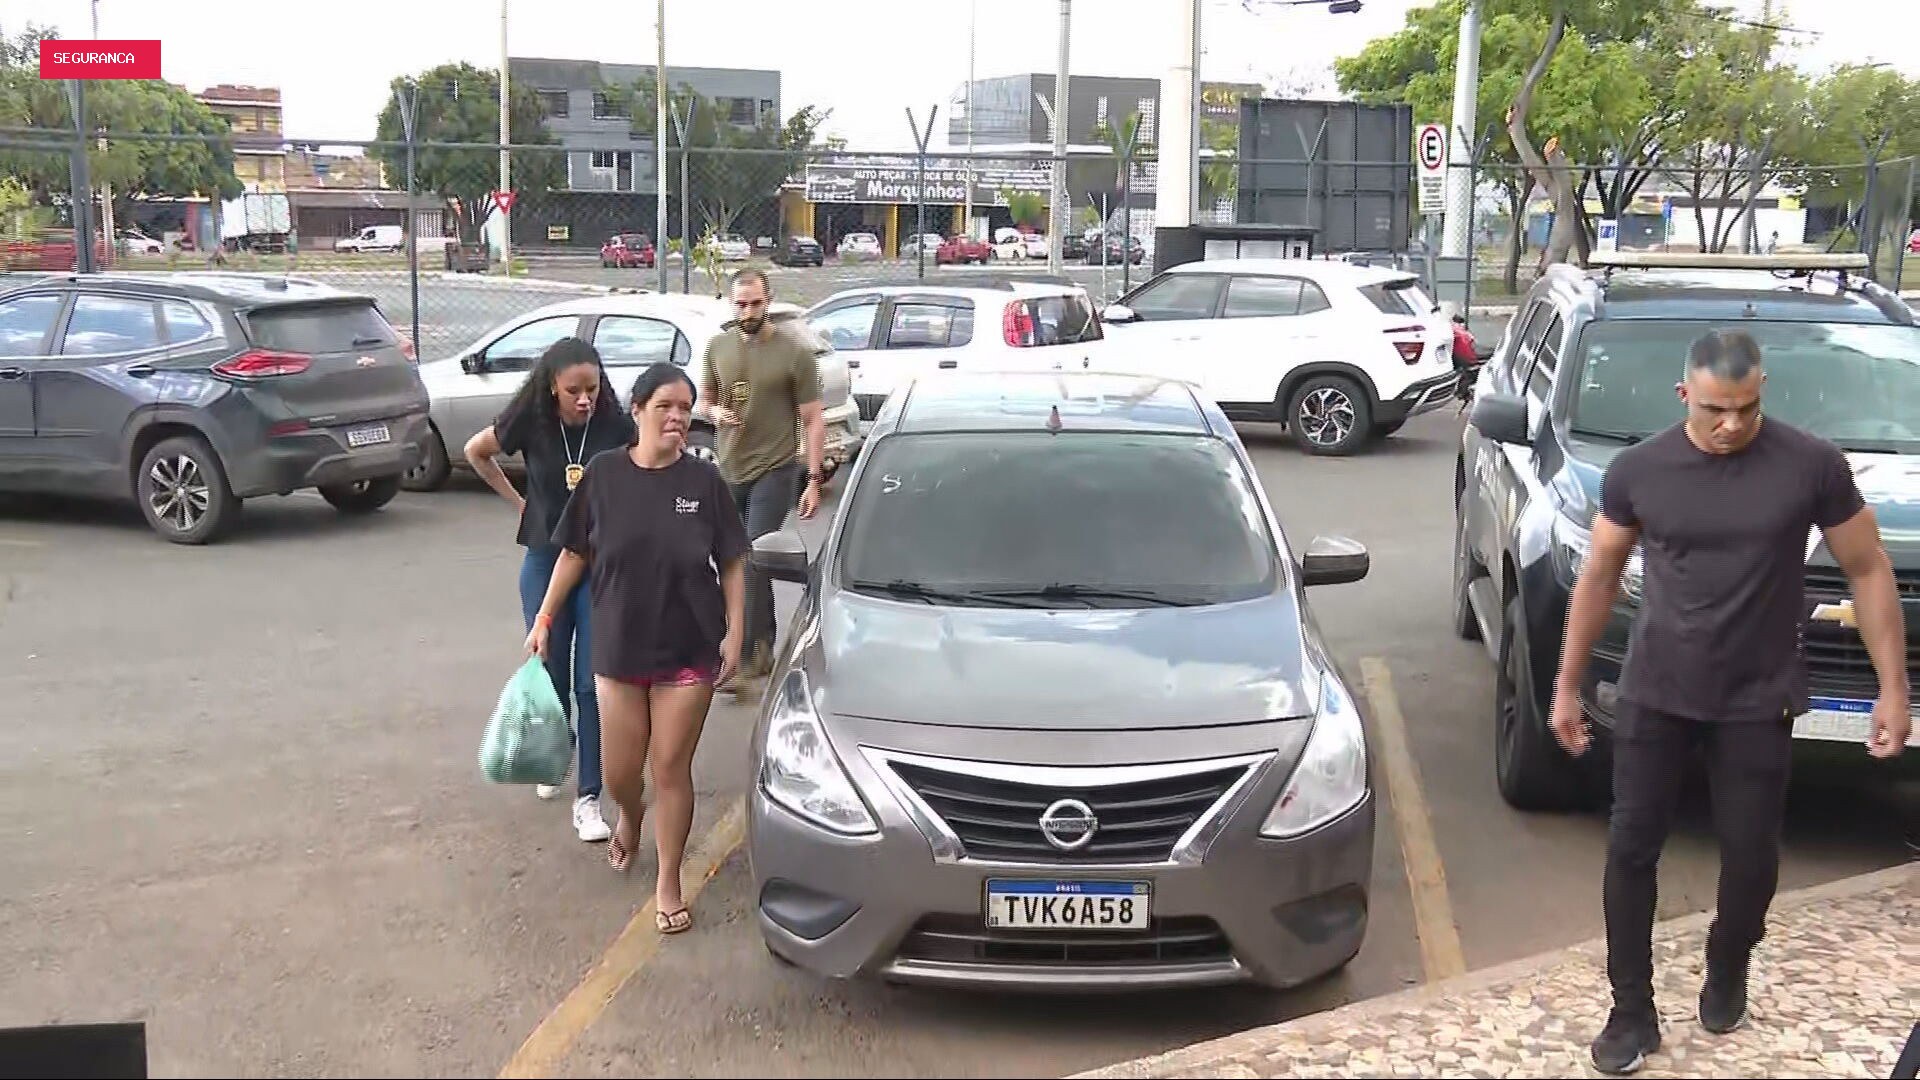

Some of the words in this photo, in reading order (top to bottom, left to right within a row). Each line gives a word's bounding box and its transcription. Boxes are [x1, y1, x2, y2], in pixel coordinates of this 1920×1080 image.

[1426, 135, 1437, 161] E
[853, 169, 877, 180] AUTO
[913, 171, 941, 181] TOCA
[955, 169, 978, 182] ÓLO
[866, 179, 966, 203] Marqunhos
[1004, 896, 1134, 925] TVK6A58
